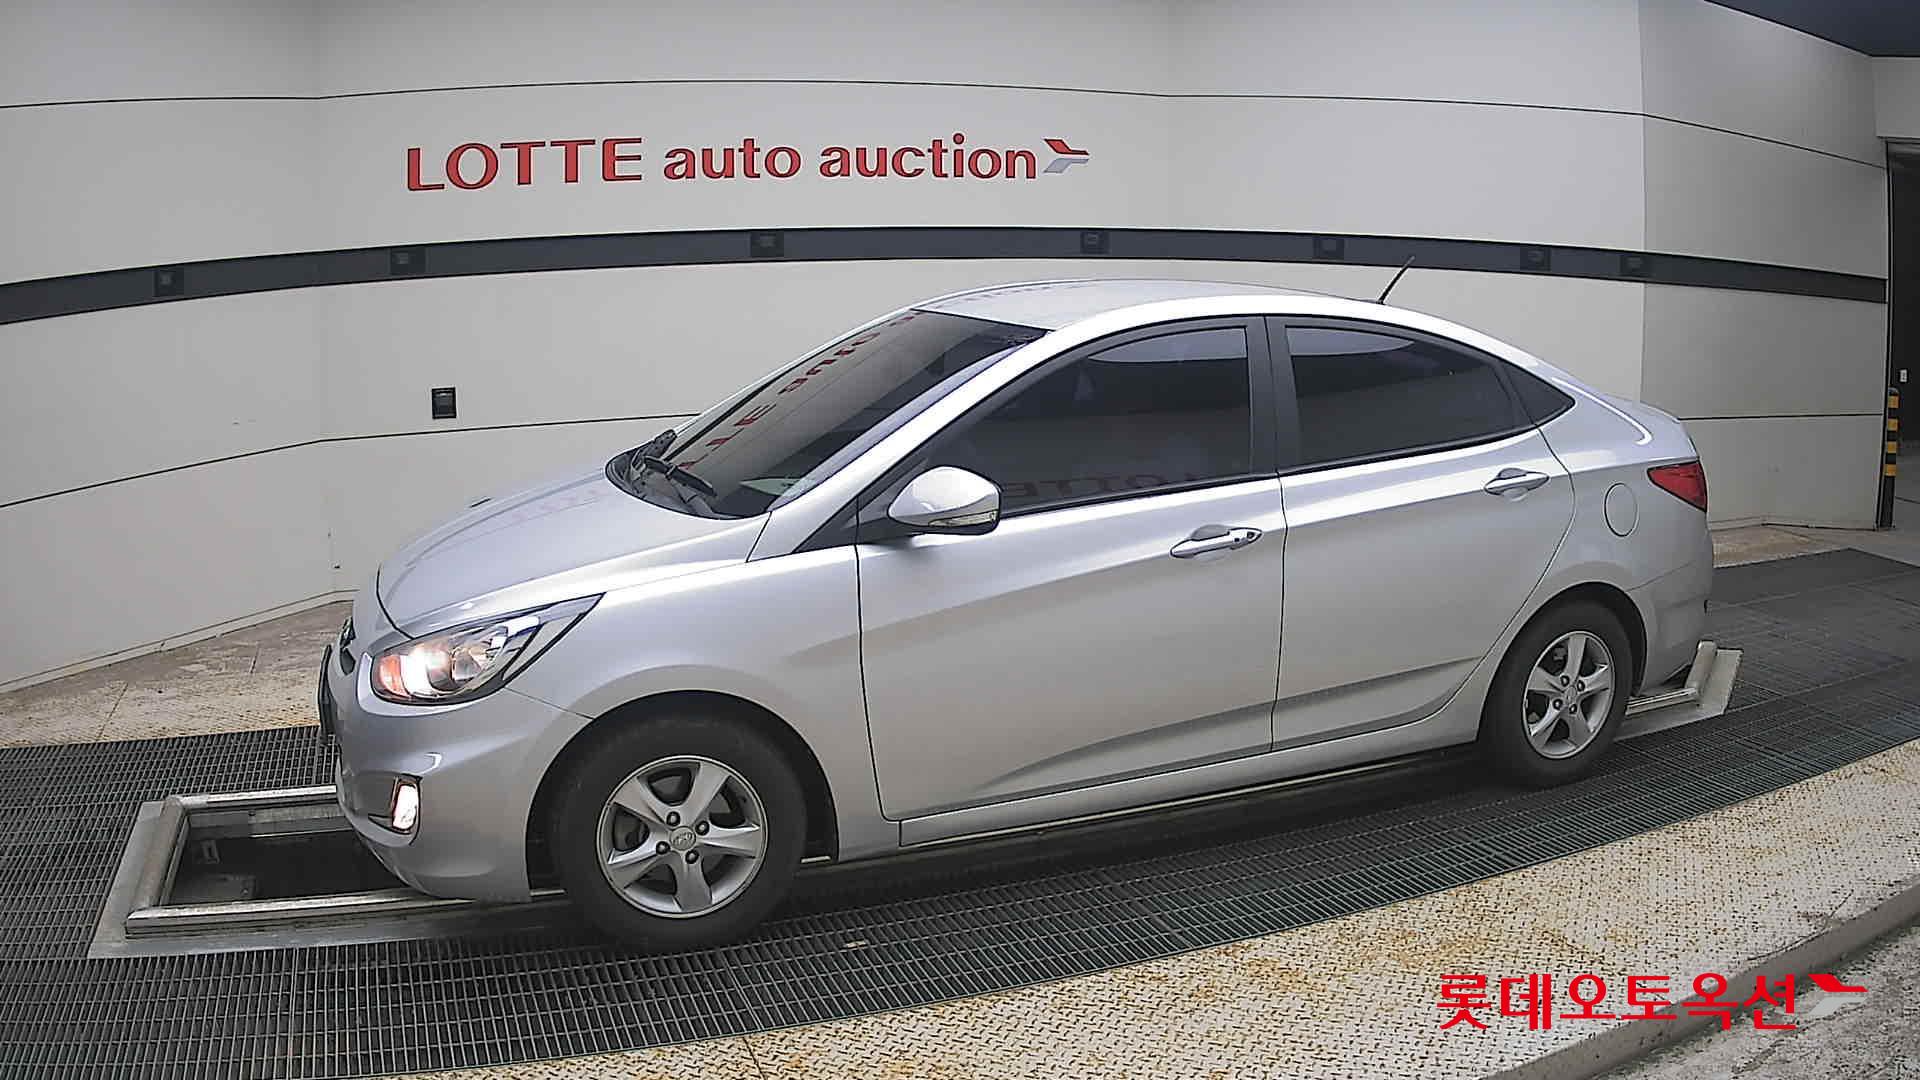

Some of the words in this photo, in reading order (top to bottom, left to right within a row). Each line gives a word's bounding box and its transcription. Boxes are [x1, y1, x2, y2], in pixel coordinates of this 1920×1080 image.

[407, 137, 642, 191] LOTTE
[664, 137, 801, 180] auto
[819, 133, 1037, 179] auction
